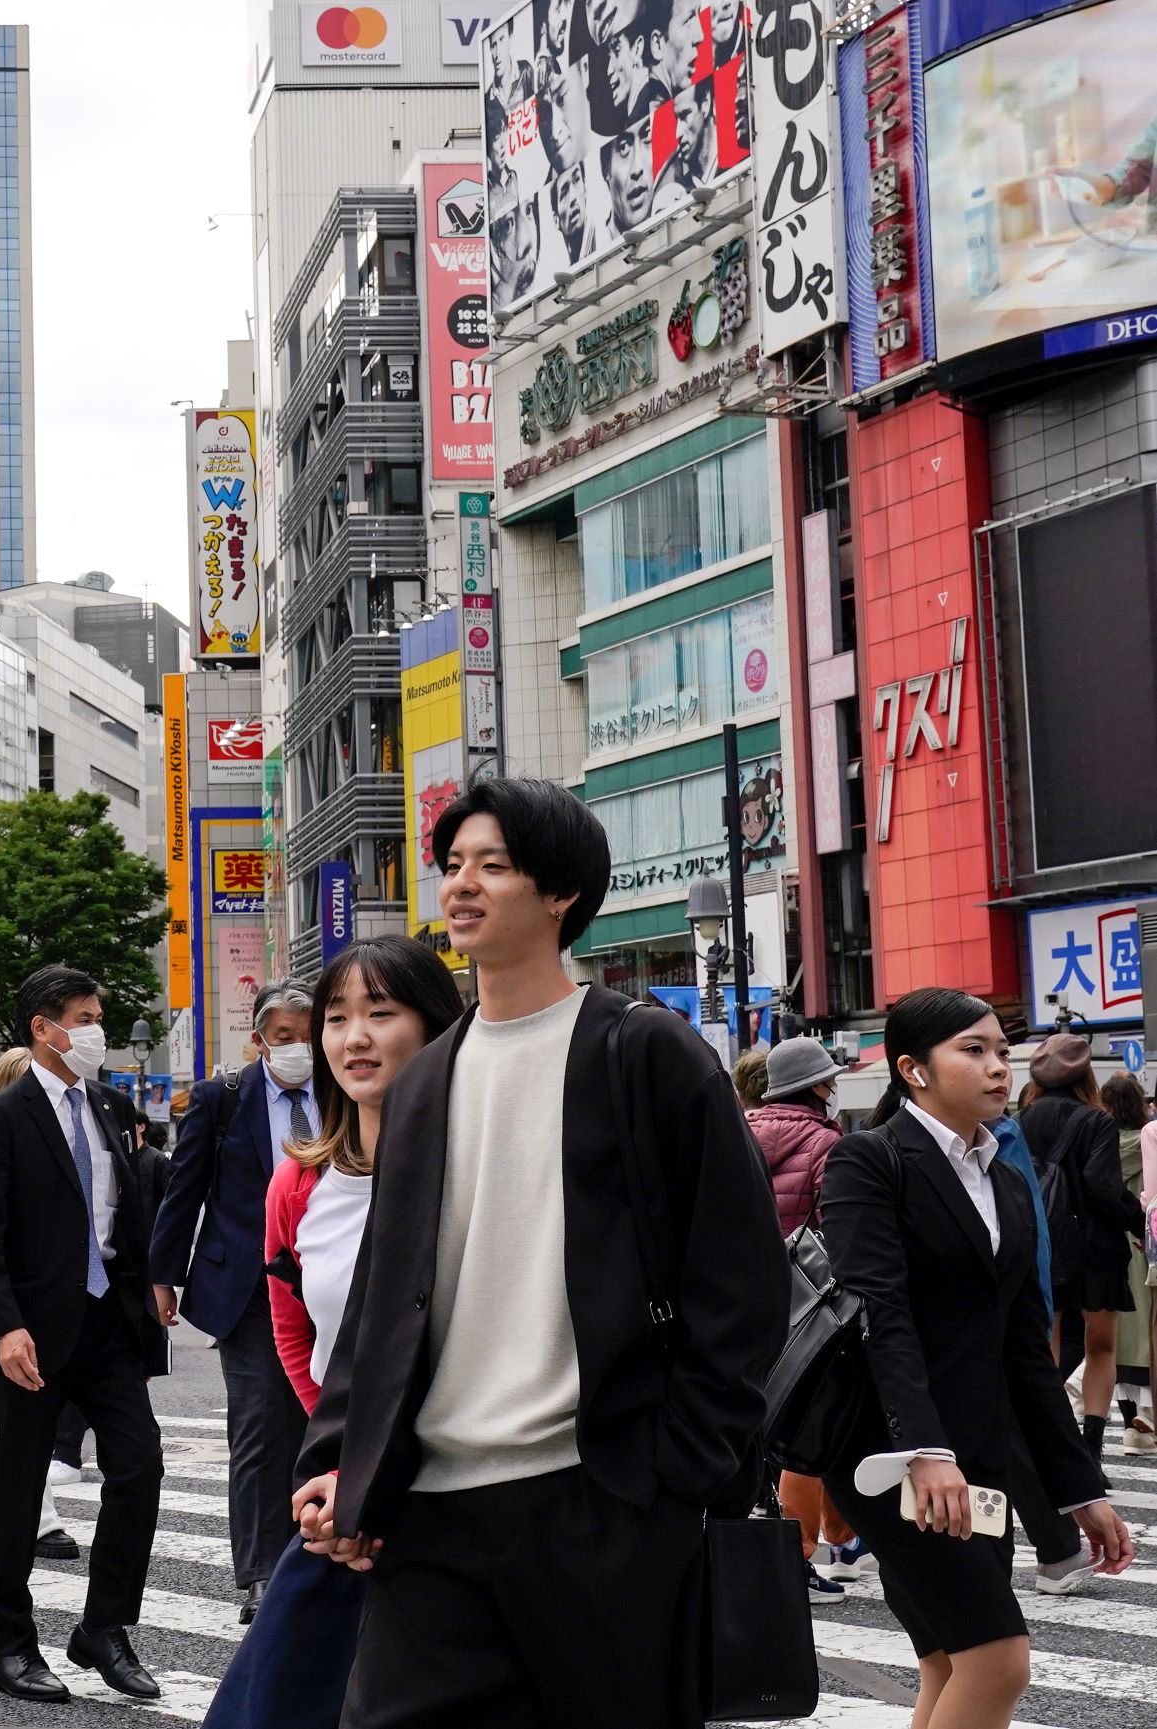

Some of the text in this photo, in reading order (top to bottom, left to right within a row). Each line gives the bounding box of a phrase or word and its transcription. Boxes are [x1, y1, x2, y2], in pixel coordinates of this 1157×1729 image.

[320, 52, 385, 61] mastercard
[862, 25, 910, 358] 三千里薬品
[396, 390, 409, 398] 7F
[443, 444, 473, 461] VILLAGE
[203, 515, 226, 618] つかえる!
[470, 597, 485, 608] 4F
[406, 676, 451, 701] Matsumoto
[169, 718, 184, 862] Matsumoto KiYoshi
[224, 854, 264, 889] 薬
[332, 878, 344, 938] MIZUHO
[172, 920, 188, 934] 薬
